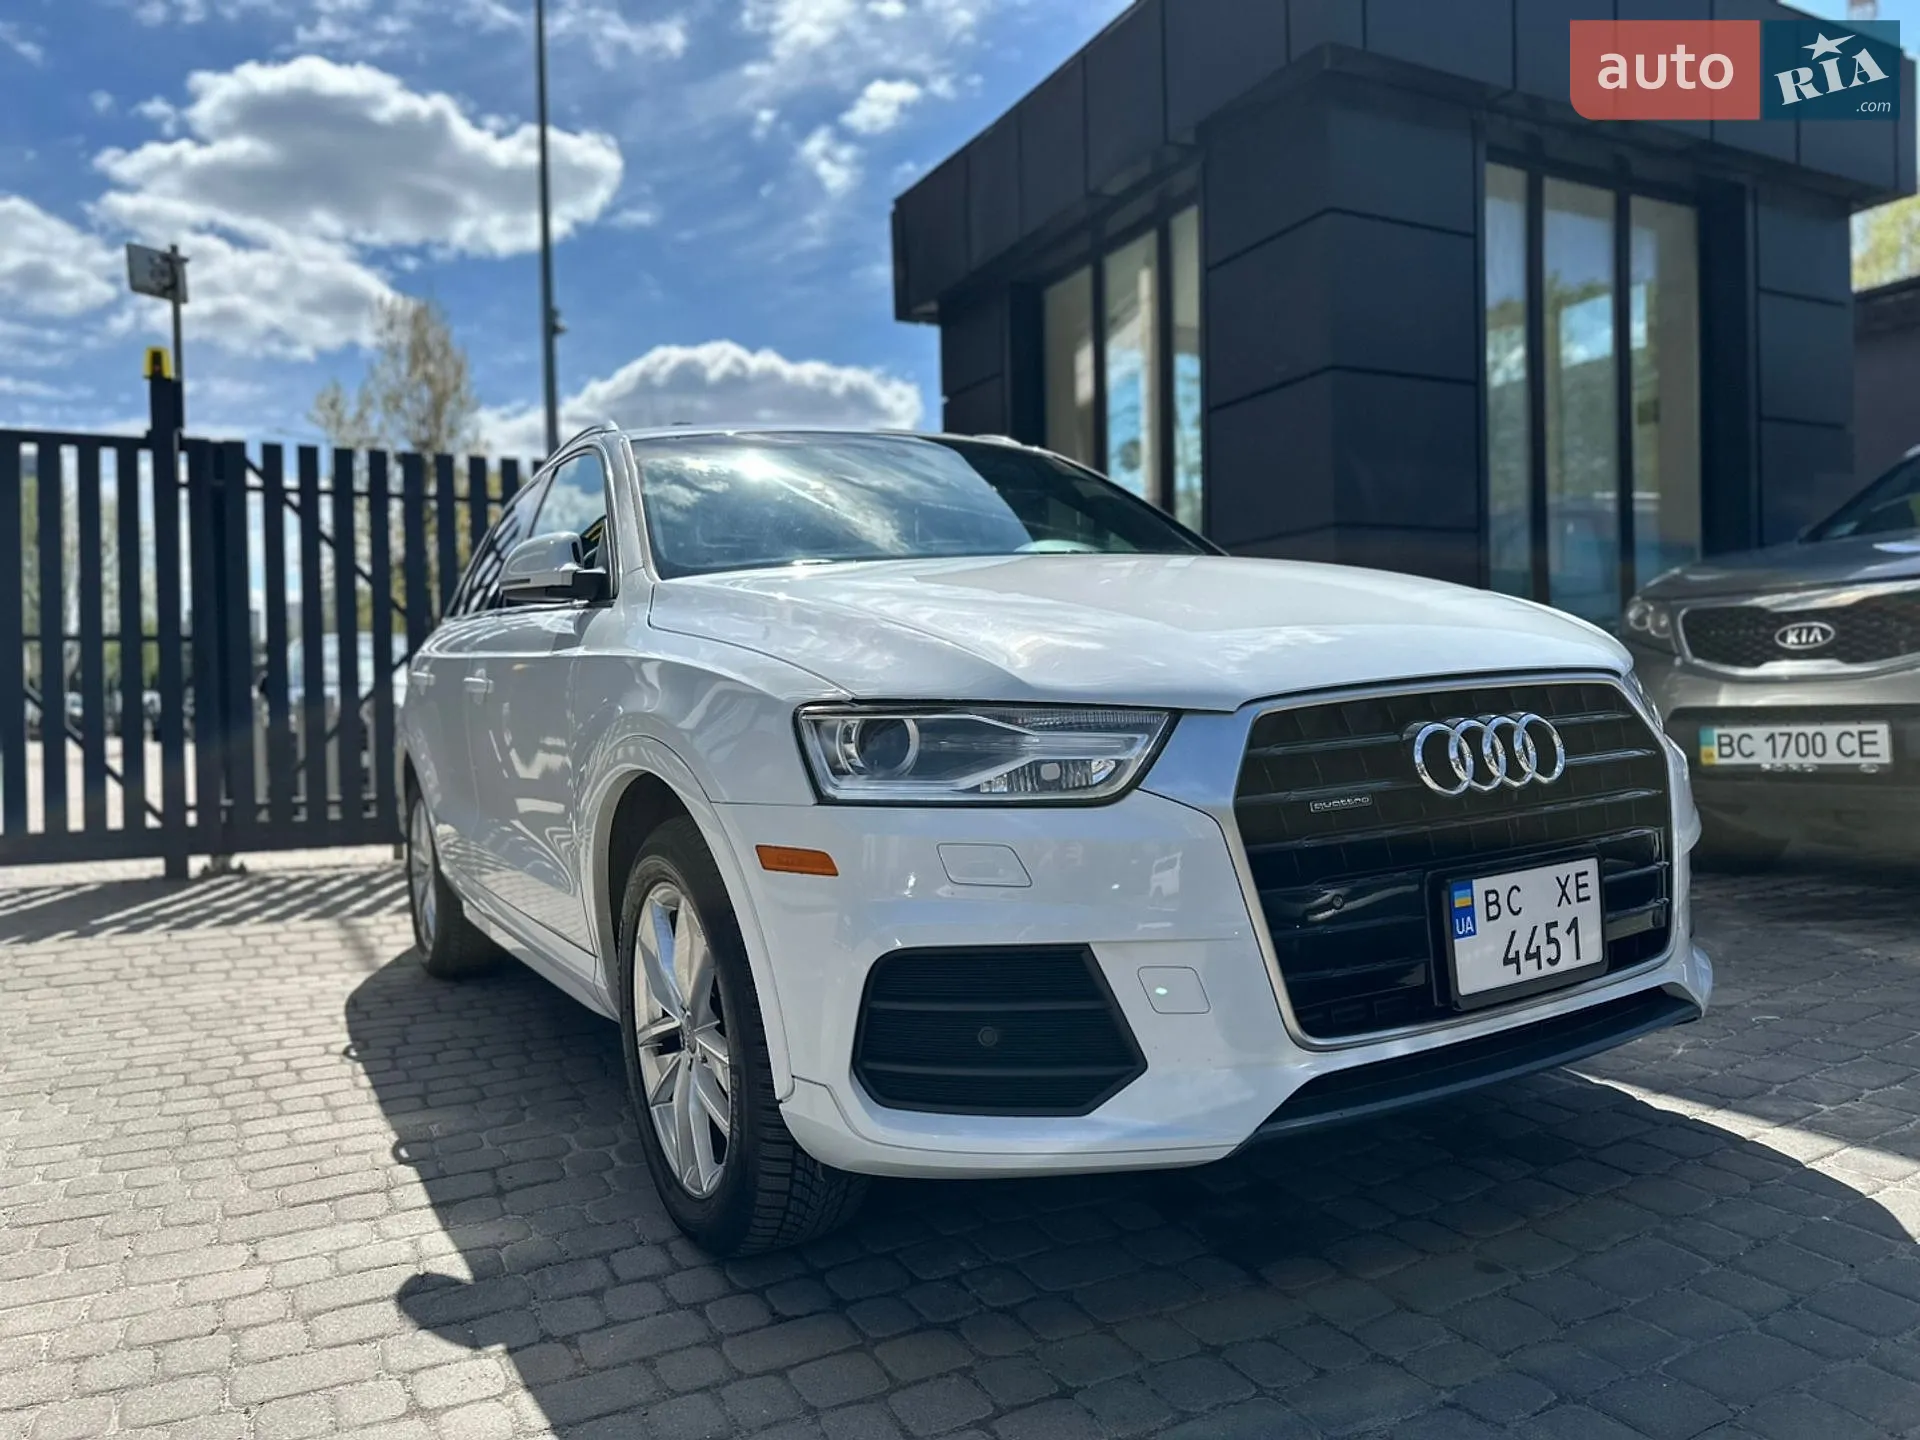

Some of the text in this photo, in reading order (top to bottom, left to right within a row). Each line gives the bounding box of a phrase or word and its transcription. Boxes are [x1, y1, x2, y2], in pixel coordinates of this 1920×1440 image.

[1786, 628, 1824, 645] KIA
[1717, 730, 1880, 759] BC 1700 CE
[1484, 871, 1591, 922] BC XE
[1455, 916, 1475, 935] UA
[1502, 916, 1581, 975] 4451
